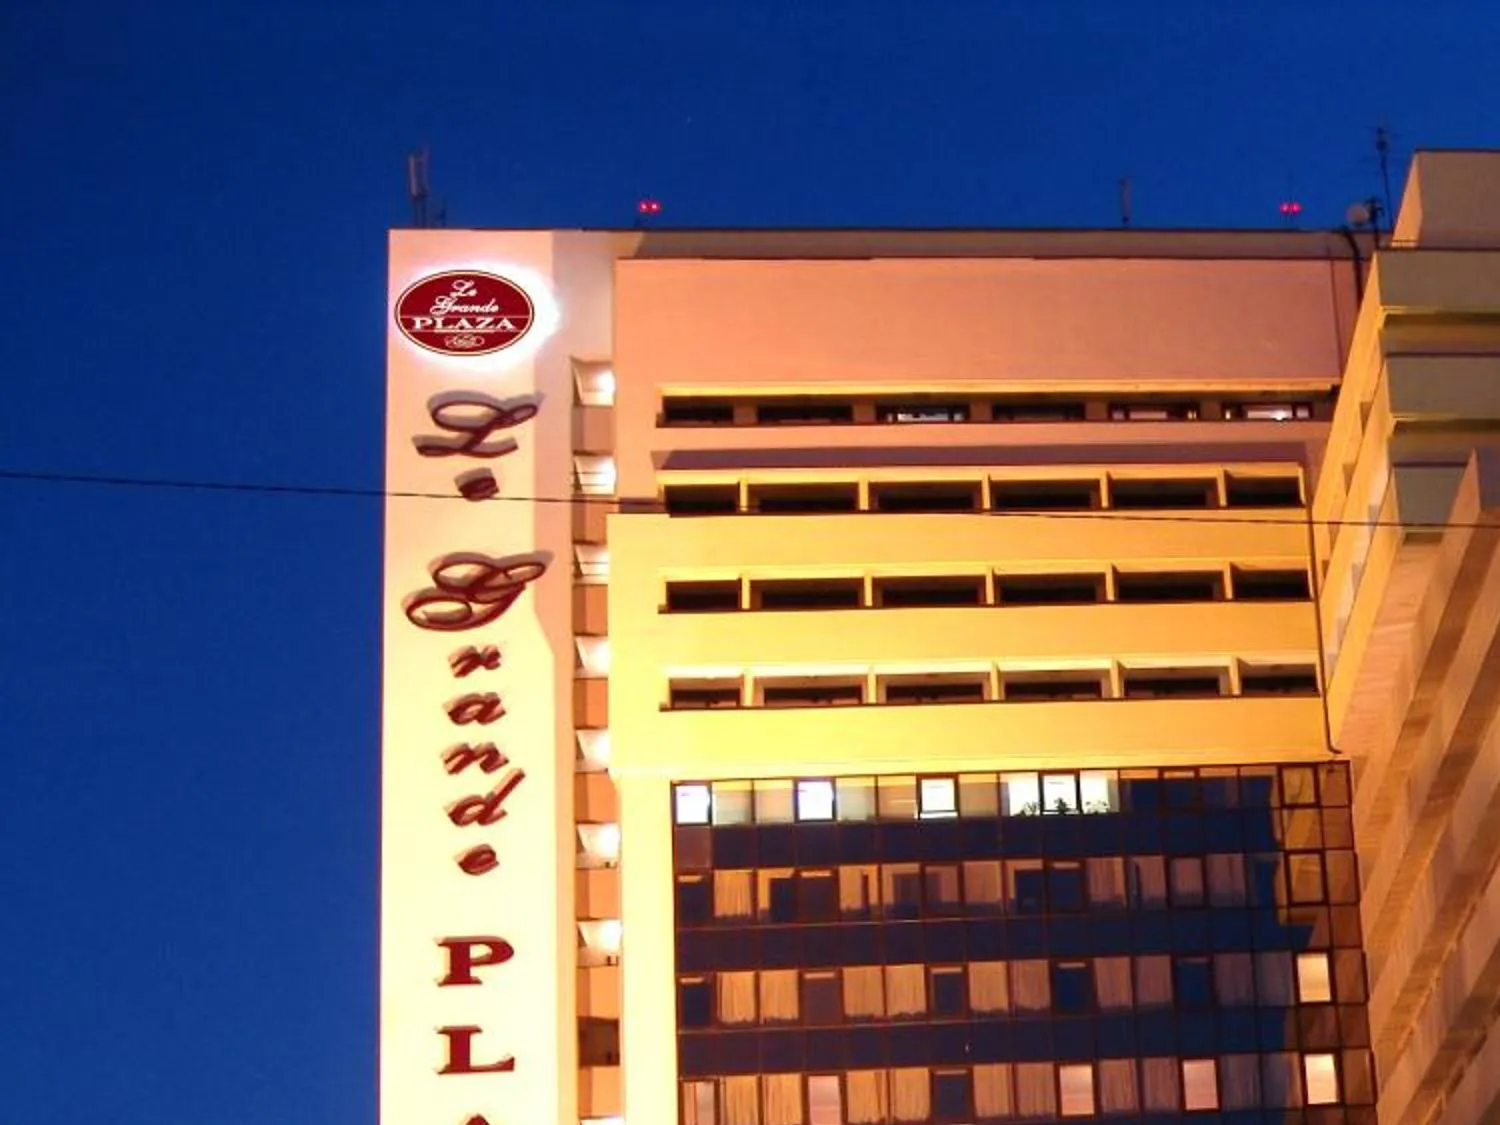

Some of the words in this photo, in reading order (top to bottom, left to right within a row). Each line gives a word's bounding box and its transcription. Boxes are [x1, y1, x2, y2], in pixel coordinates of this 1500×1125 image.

[450, 279, 477, 297] Le
[430, 296, 499, 315] Grande
[412, 316, 518, 330] PLAZA
[403, 551, 551, 876] Grande
